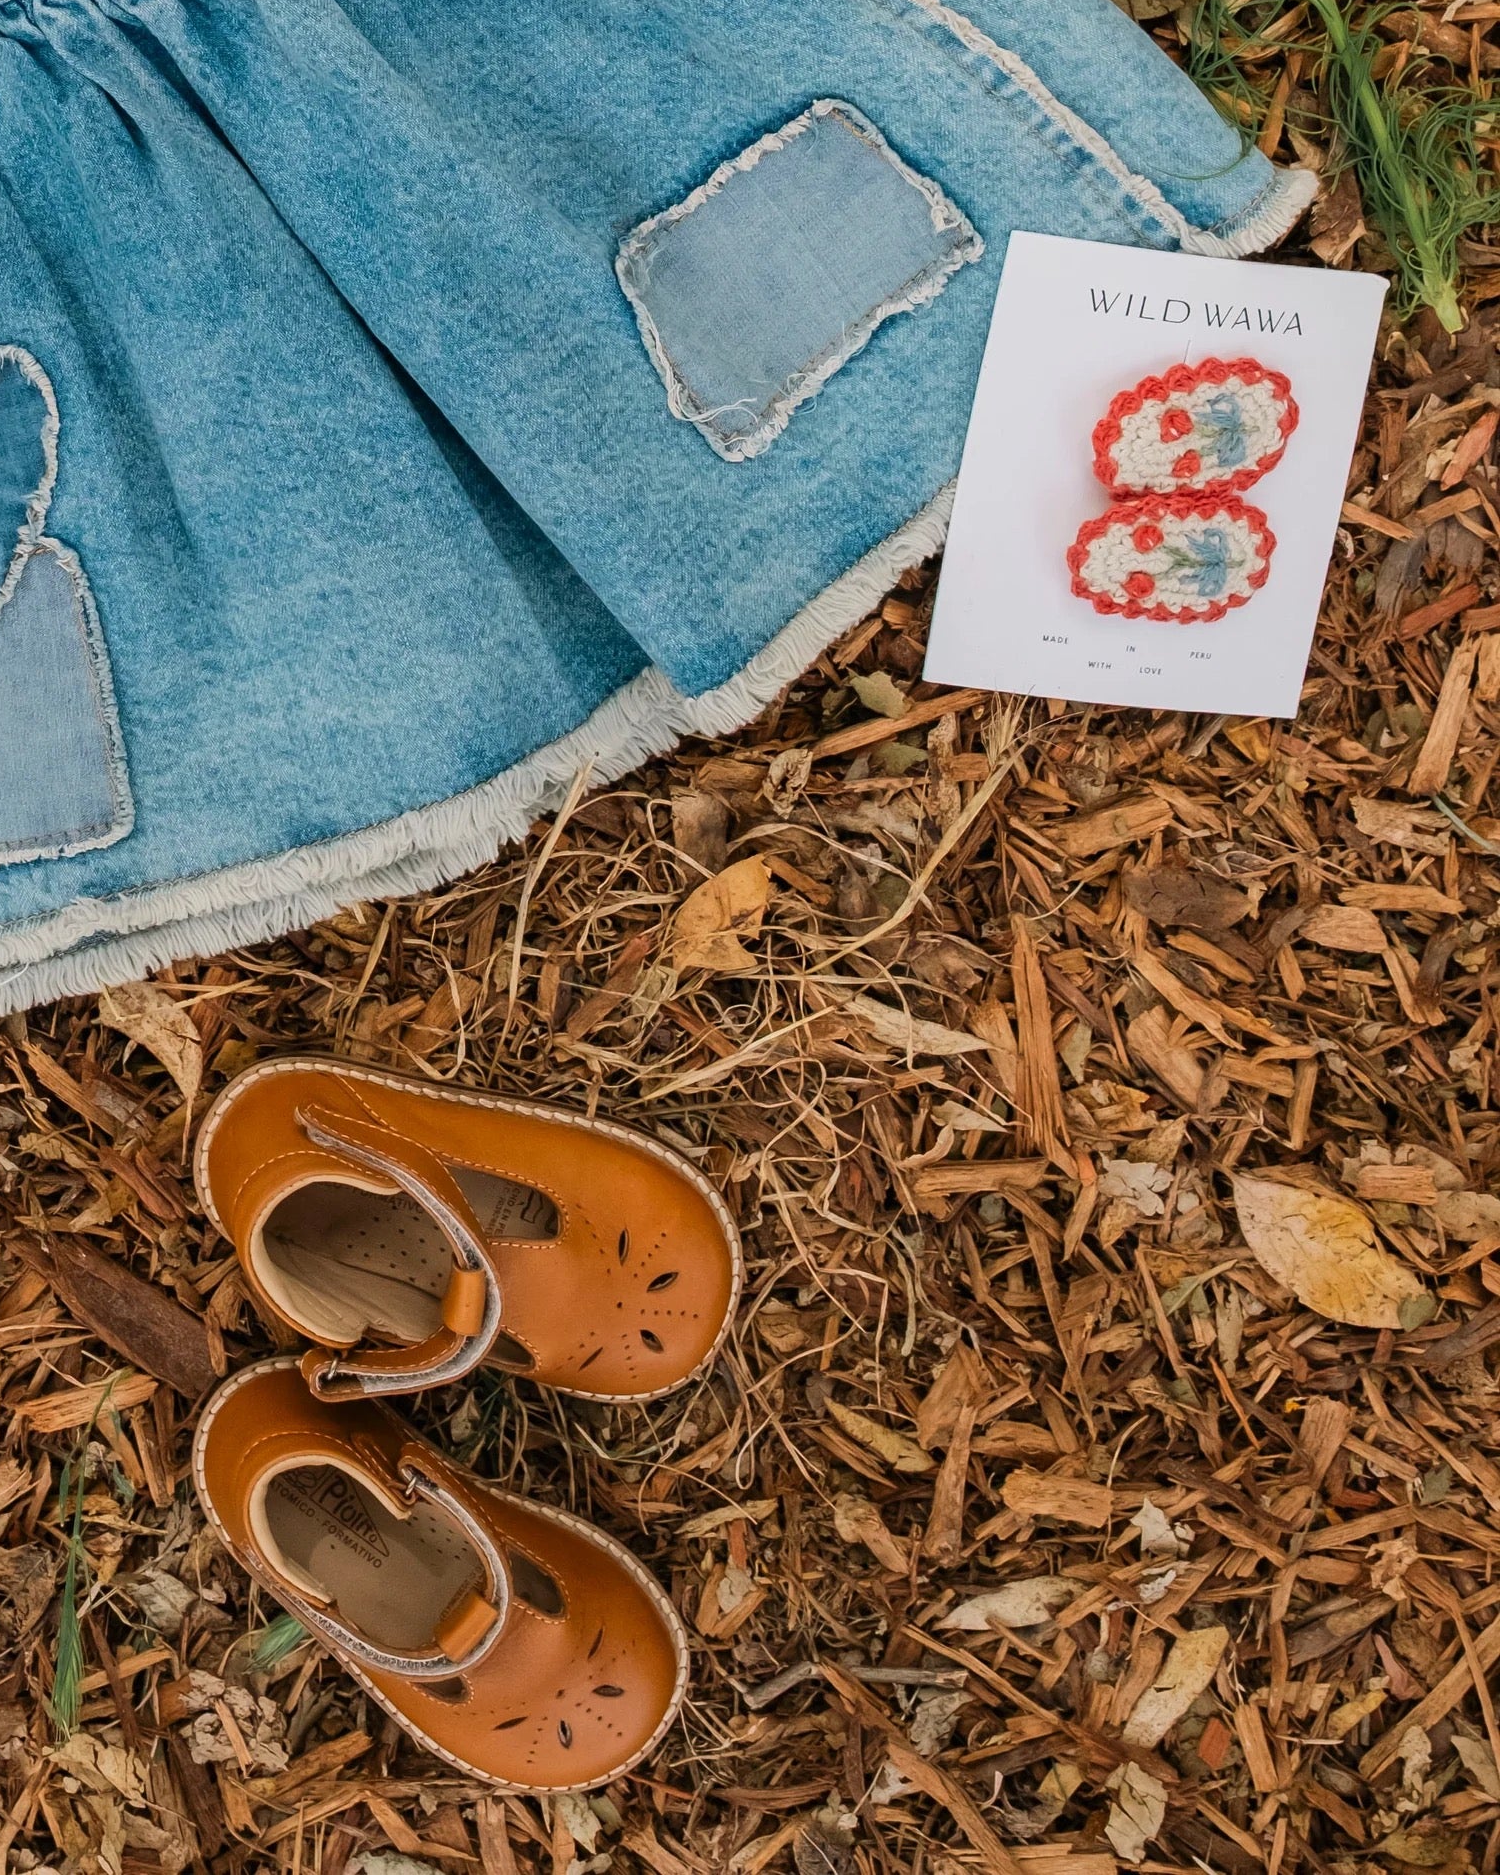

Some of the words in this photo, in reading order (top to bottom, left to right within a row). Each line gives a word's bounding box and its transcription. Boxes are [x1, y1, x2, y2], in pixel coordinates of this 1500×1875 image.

[1090, 288, 1191, 324] WILD
[1204, 302, 1303, 336] WAWA
[1042, 635, 1069, 645] MADE
[1125, 645, 1136, 653] IN
[1189, 651, 1212, 660] PERU
[1087, 660, 1112, 670] WITH
[1139, 666, 1162, 676] LOVE
[322, 1519, 382, 1569] FORMATIVO
